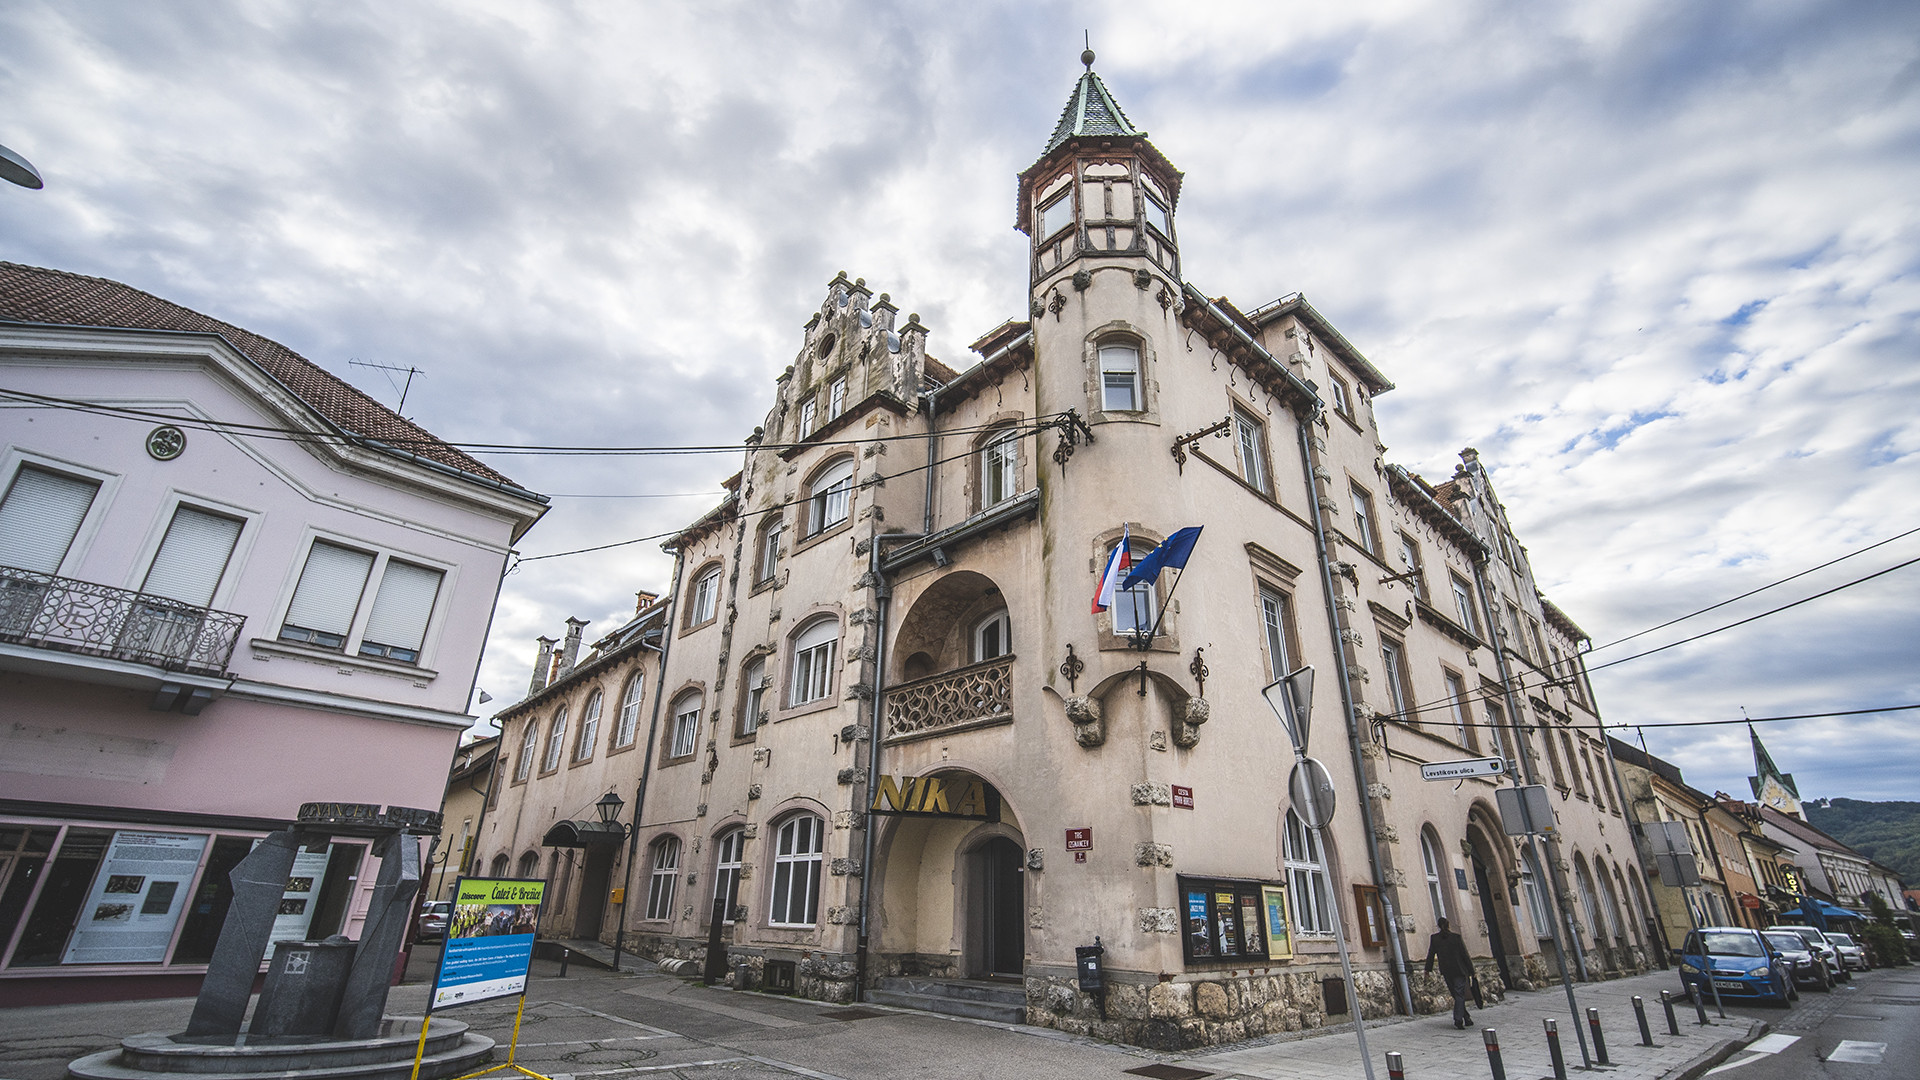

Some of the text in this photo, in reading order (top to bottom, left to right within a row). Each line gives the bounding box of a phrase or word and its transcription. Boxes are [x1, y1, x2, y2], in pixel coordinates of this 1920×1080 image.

[871, 774, 988, 816] NIKA
[460, 892, 487, 900] Discover
[510, 886, 518, 900] &
[518, 886, 542, 900] Brežice
